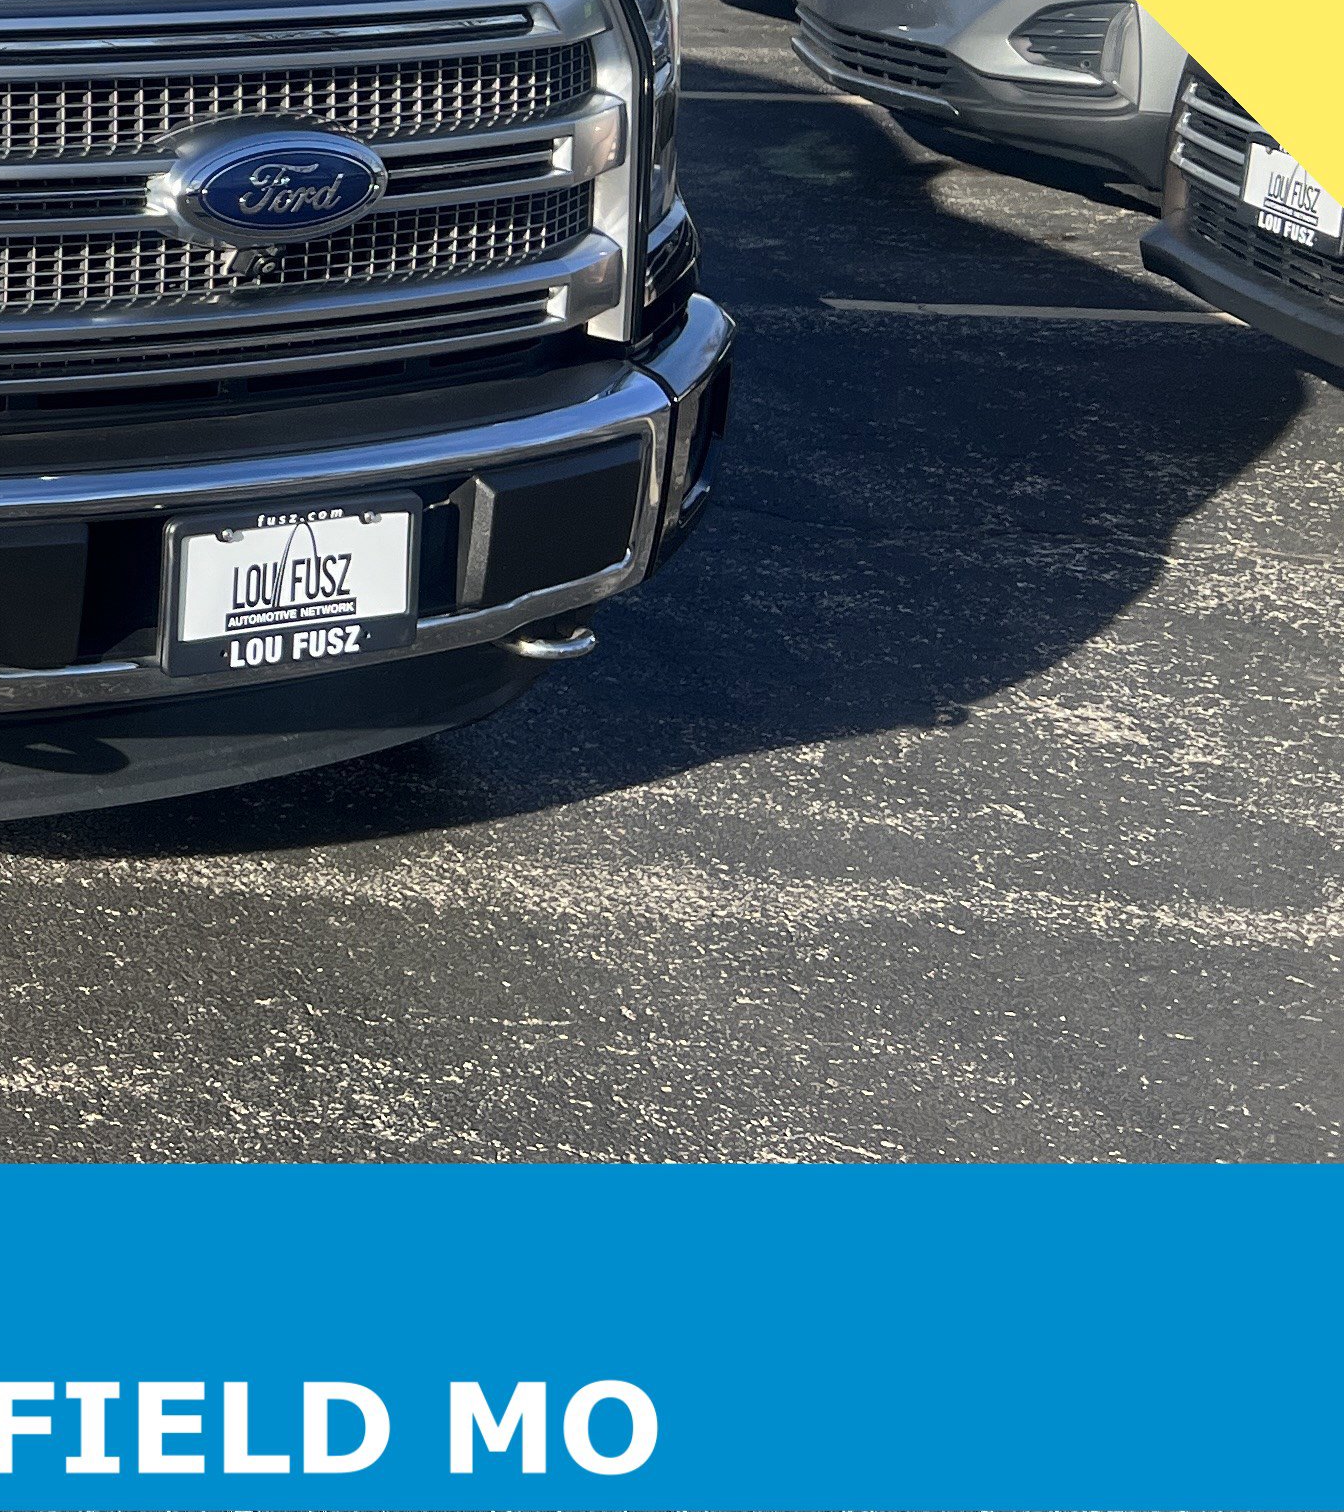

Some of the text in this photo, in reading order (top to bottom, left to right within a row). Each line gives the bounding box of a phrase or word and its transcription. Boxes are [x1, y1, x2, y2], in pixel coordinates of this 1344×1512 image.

[239, 163, 344, 215] Ford
[1268, 171, 1291, 202] LOU
[1291, 179, 1321, 213] FUSZ
[1257, 210, 1283, 234] LOU
[1283, 220, 1316, 247] FUSZ
[257, 508, 344, 528] fusz.com
[232, 553, 353, 610] LOU FUSZ
[228, 600, 354, 628] AUTOMOTIVE NETWORK
[230, 624, 362, 668] LOU FUSZ
